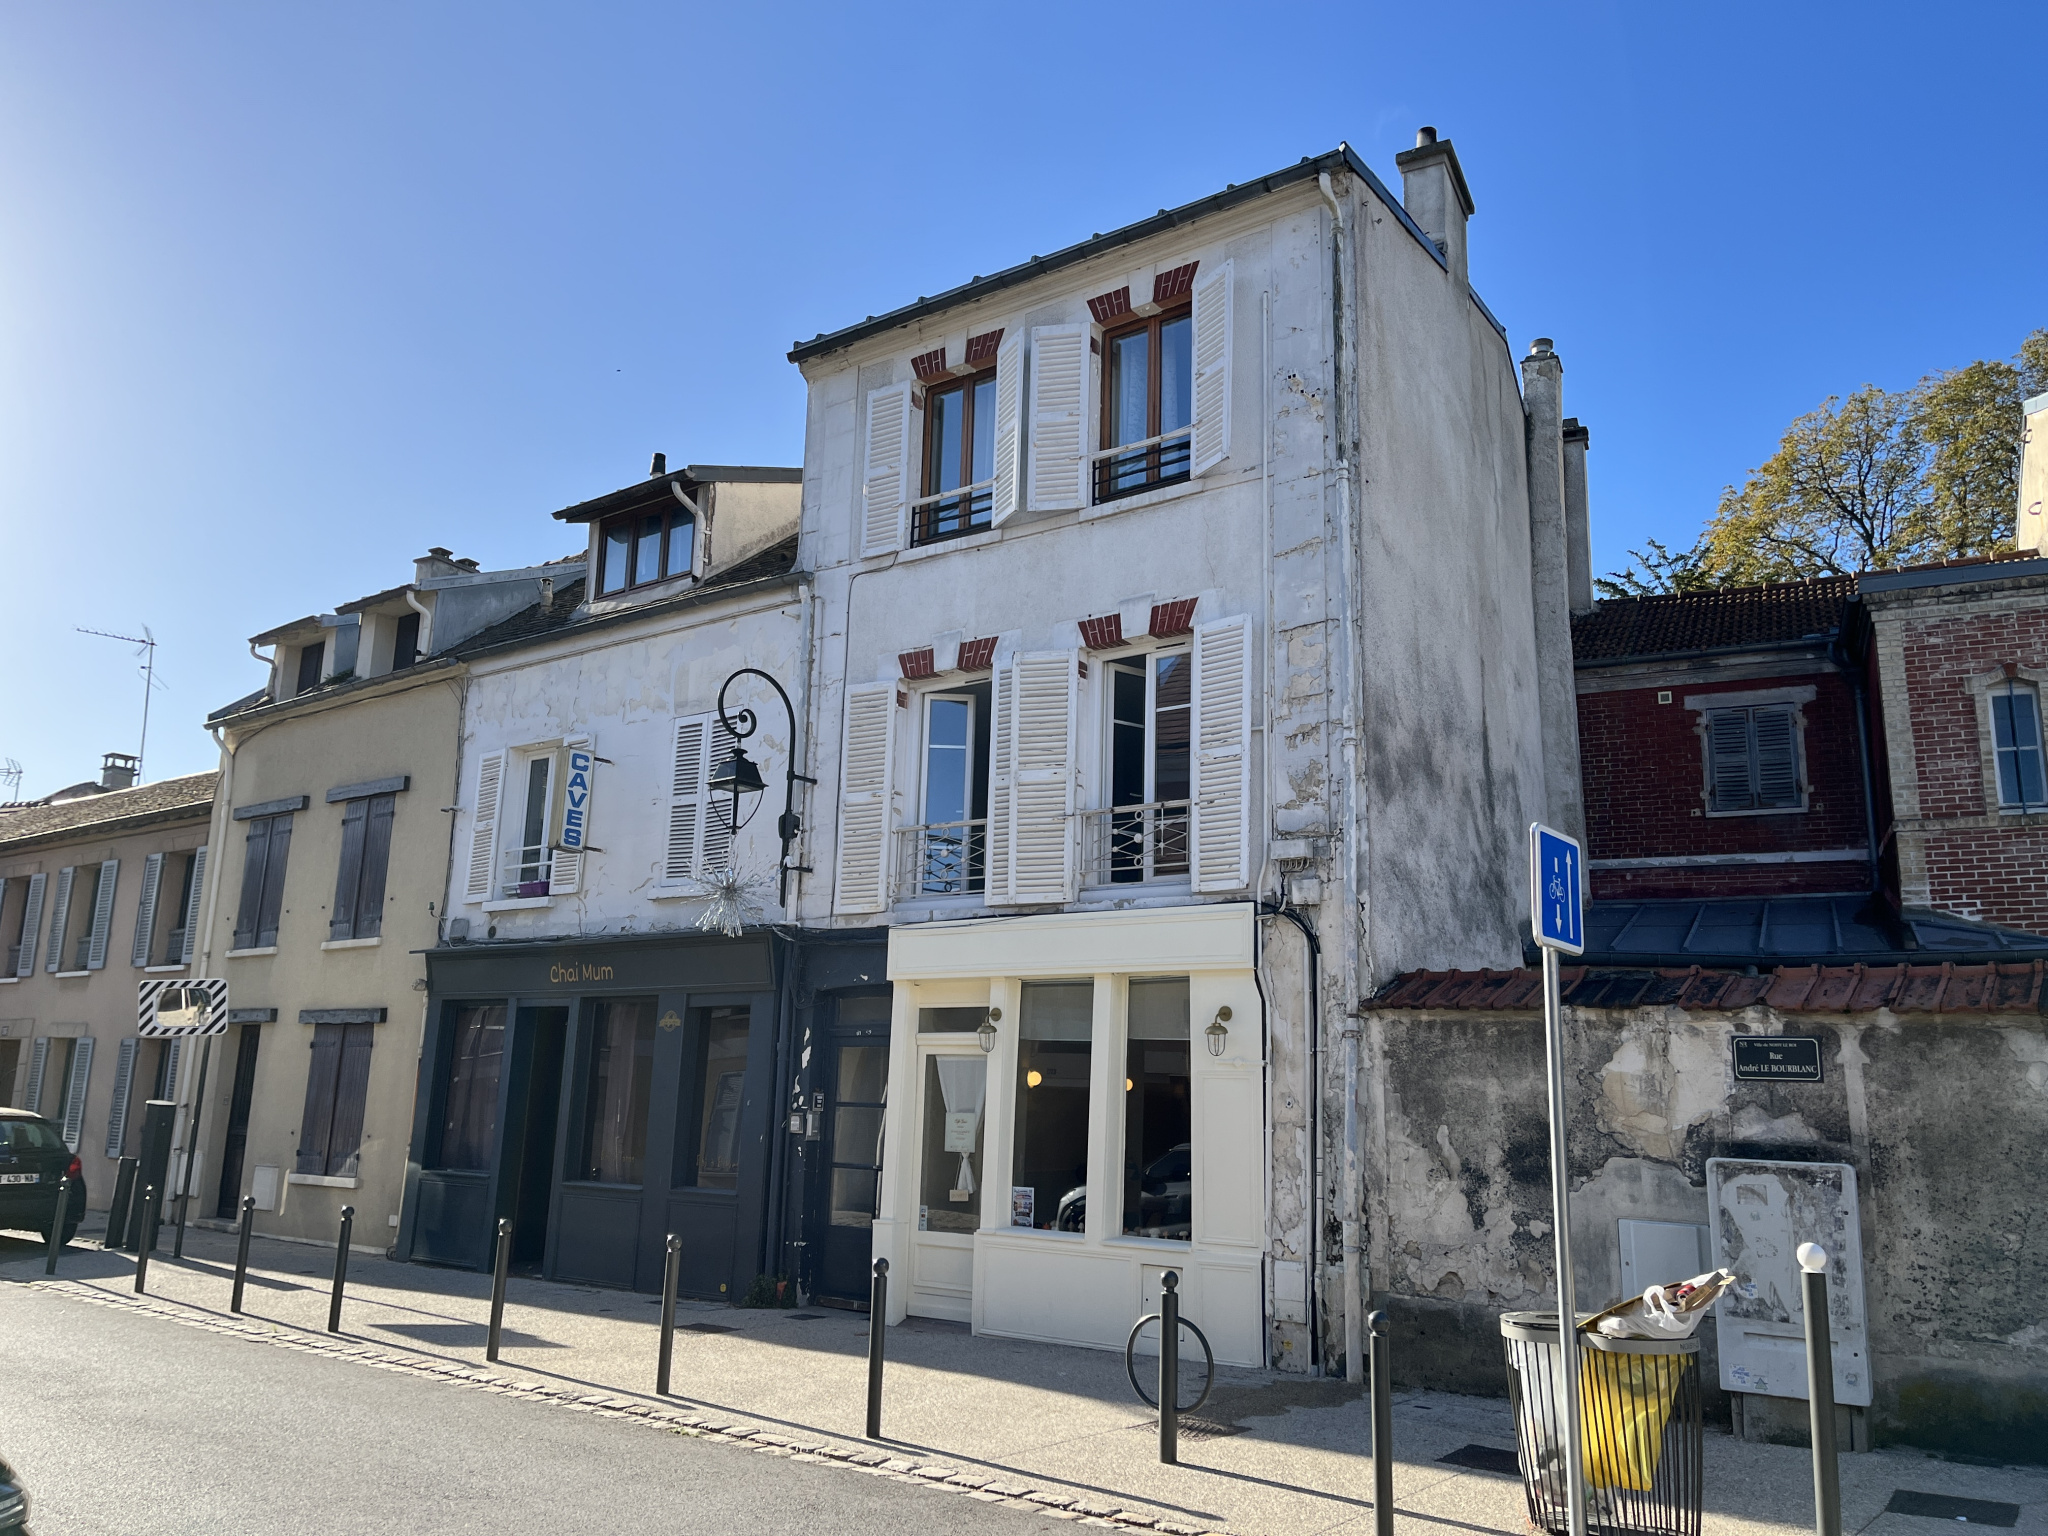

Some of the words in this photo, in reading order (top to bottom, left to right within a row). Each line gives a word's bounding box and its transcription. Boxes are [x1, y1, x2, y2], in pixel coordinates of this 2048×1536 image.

[563, 752, 590, 847] CAVES
[550, 961, 579, 983] Chai
[582, 963, 614, 981] Mum
[1769, 1052, 1783, 1060] Rue
[1739, 1063, 1759, 1072] André
[1760, 1064, 1770, 1072] LE
[1771, 1064, 1817, 1073] BOURBLANC
